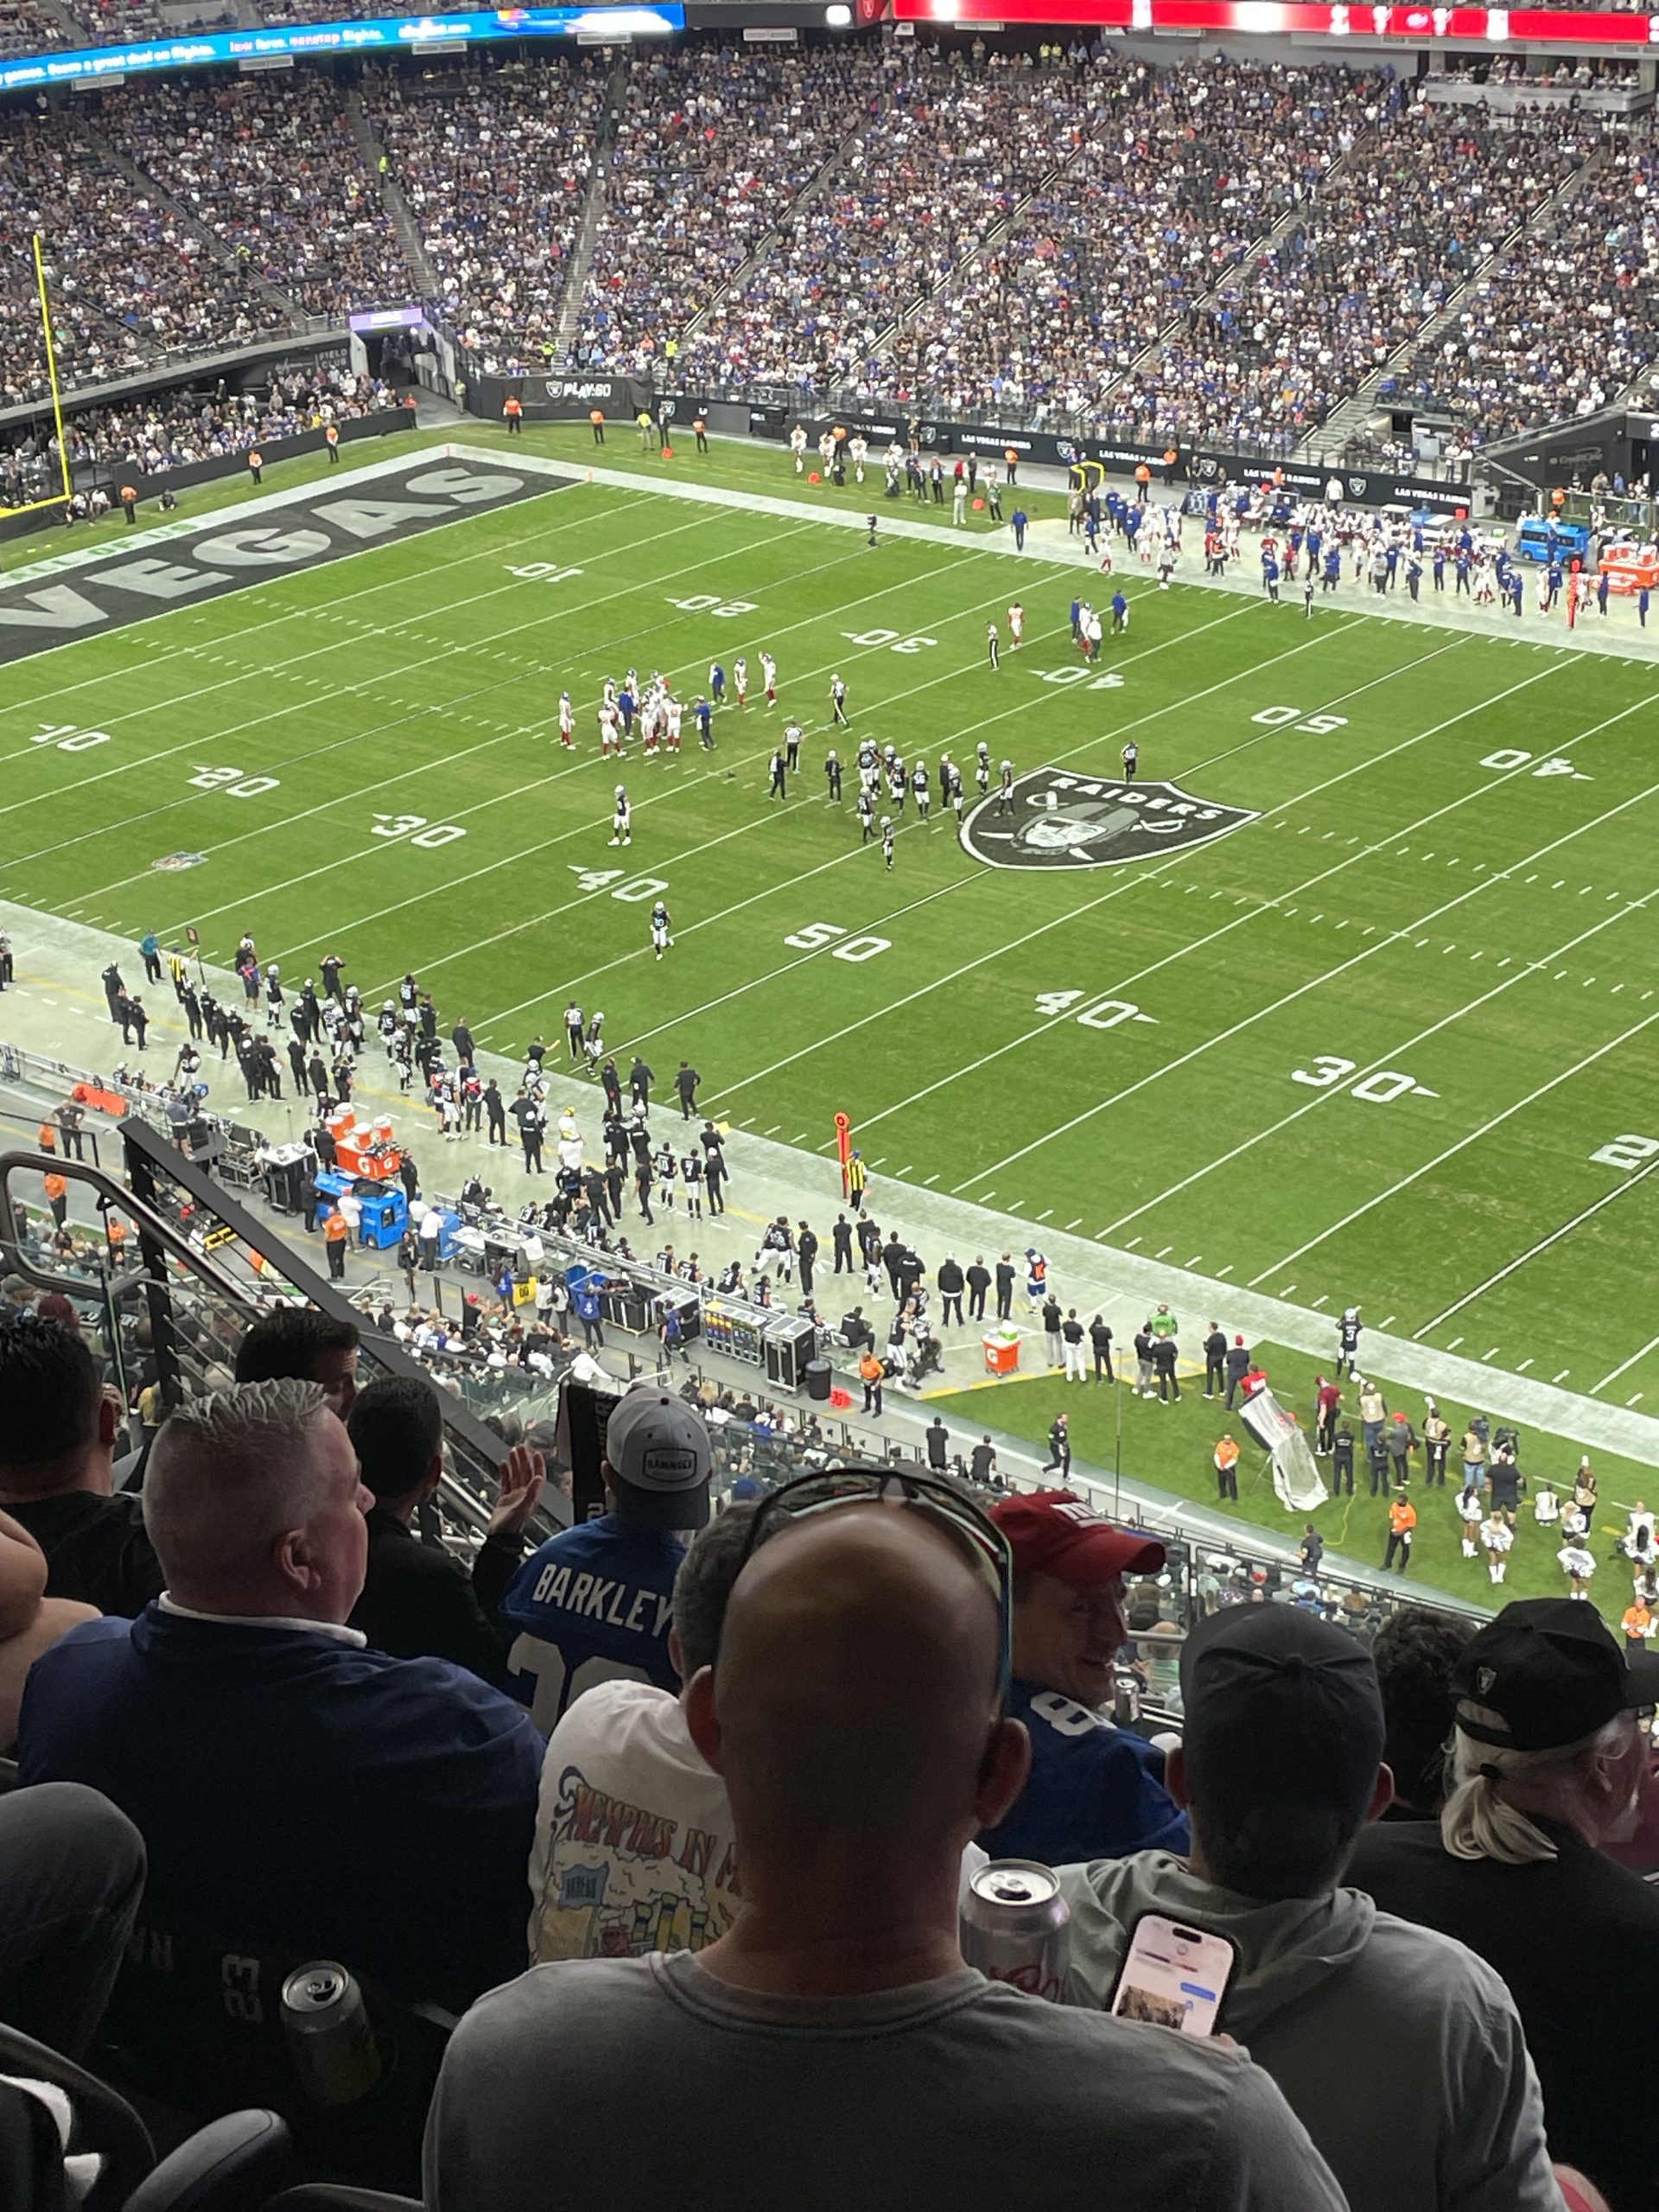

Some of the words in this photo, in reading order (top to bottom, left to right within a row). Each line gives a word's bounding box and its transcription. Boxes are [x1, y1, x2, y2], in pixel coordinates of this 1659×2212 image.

[0, 467, 524, 628] VEGAS
[676, 594, 760, 618] 20
[853, 628, 938, 654] 30
[1043, 665, 1124, 690] 40
[1251, 706, 1349, 734] 50
[29, 723, 111, 752] 10
[1479, 749, 1574, 778] 40
[187, 767, 281, 798] 20
[1049, 777, 1224, 820] RAIDERS
[371, 815, 467, 848] 30
[576, 869, 670, 902] 40
[784, 922, 892, 962] 50
[1034, 988, 1138, 1029] 40
[1291, 1055, 1416, 1103] 30
[358, 1157, 371, 1174] G
[384, 1158, 393, 1169] G
[1345, 1330, 1355, 1342] 3
[987, 1349, 999, 1363] G
[532, 1563, 673, 1637] BARKLEY
